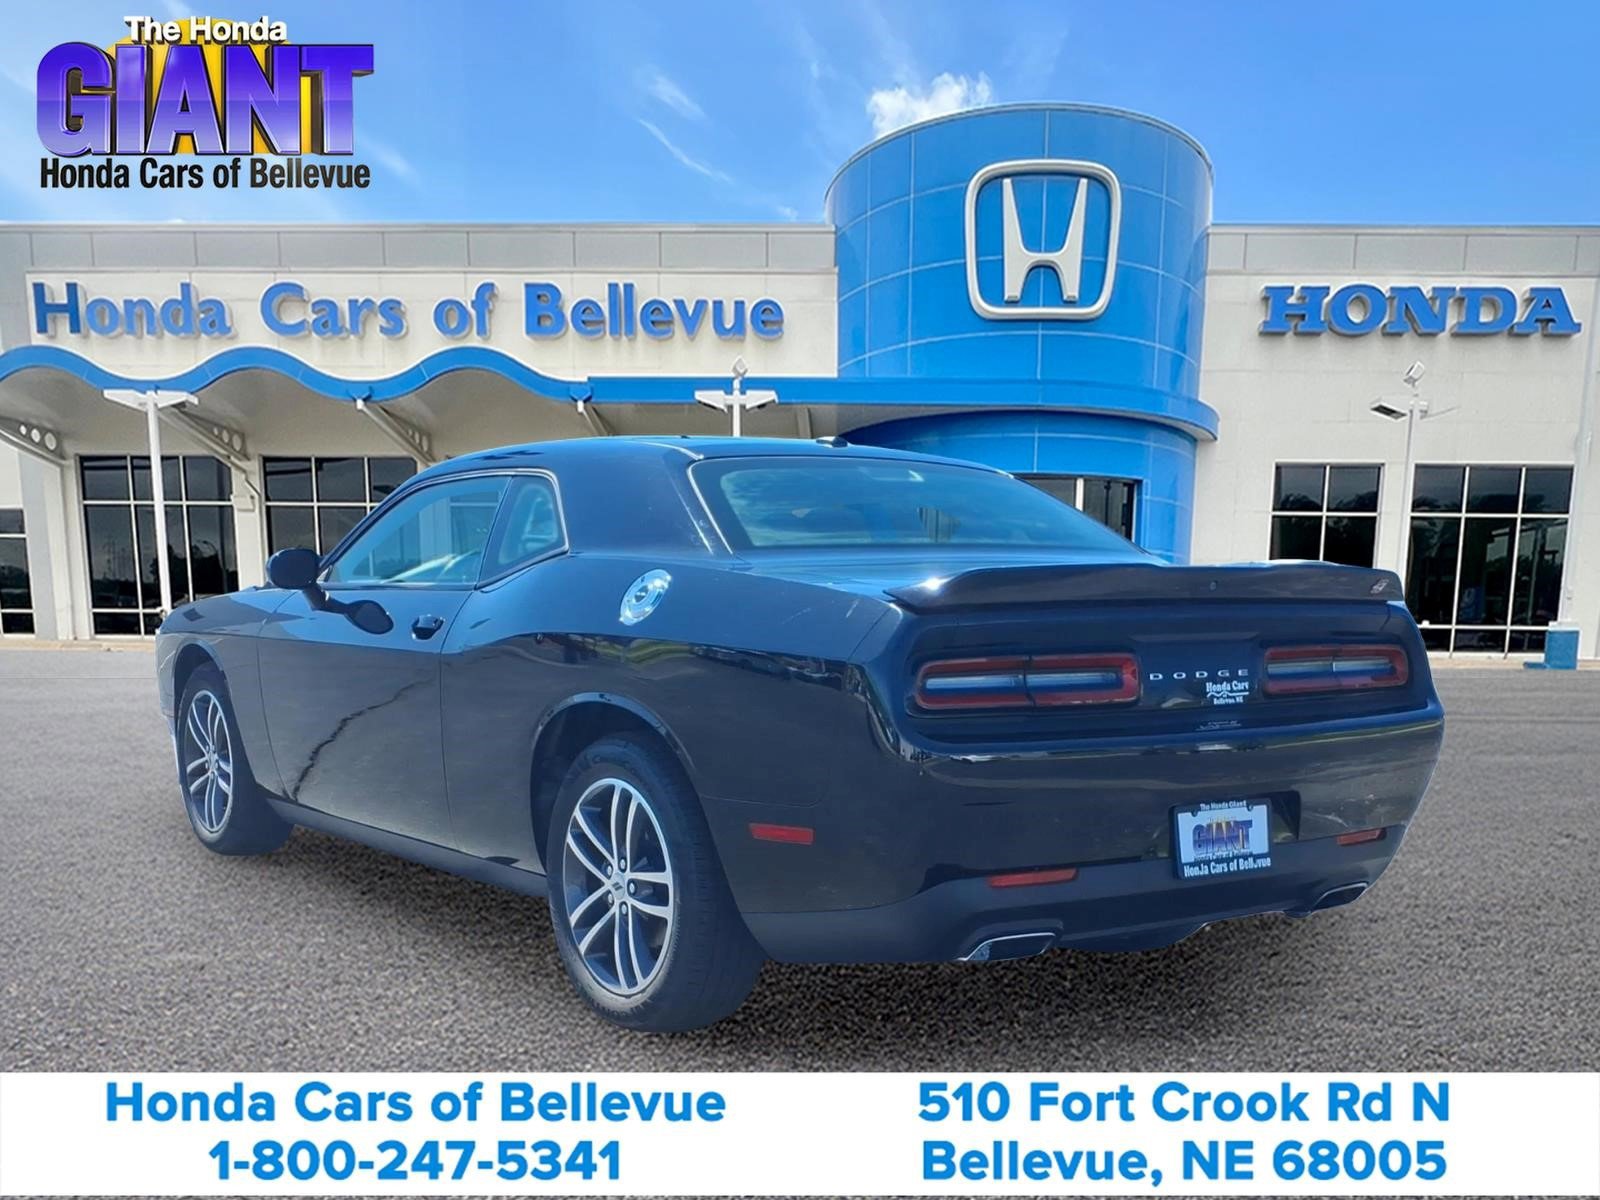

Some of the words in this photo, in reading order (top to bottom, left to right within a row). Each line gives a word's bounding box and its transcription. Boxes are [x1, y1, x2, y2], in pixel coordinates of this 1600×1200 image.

[32, 281, 231, 336] Honda
[260, 281, 406, 337] Cars
[432, 282, 497, 338] of
[523, 282, 785, 338] Bellevue
[1259, 284, 1582, 336] HONDA
[1149, 669, 1249, 681] DODGE
[1205, 681, 1231, 692] Honda
[1193, 819, 1253, 856] GIANT
[1183, 863, 1209, 878] Honda
[1210, 861, 1228, 875] Cars
[1229, 859, 1237, 872] of
[1238, 857, 1272, 871] Bellevue
